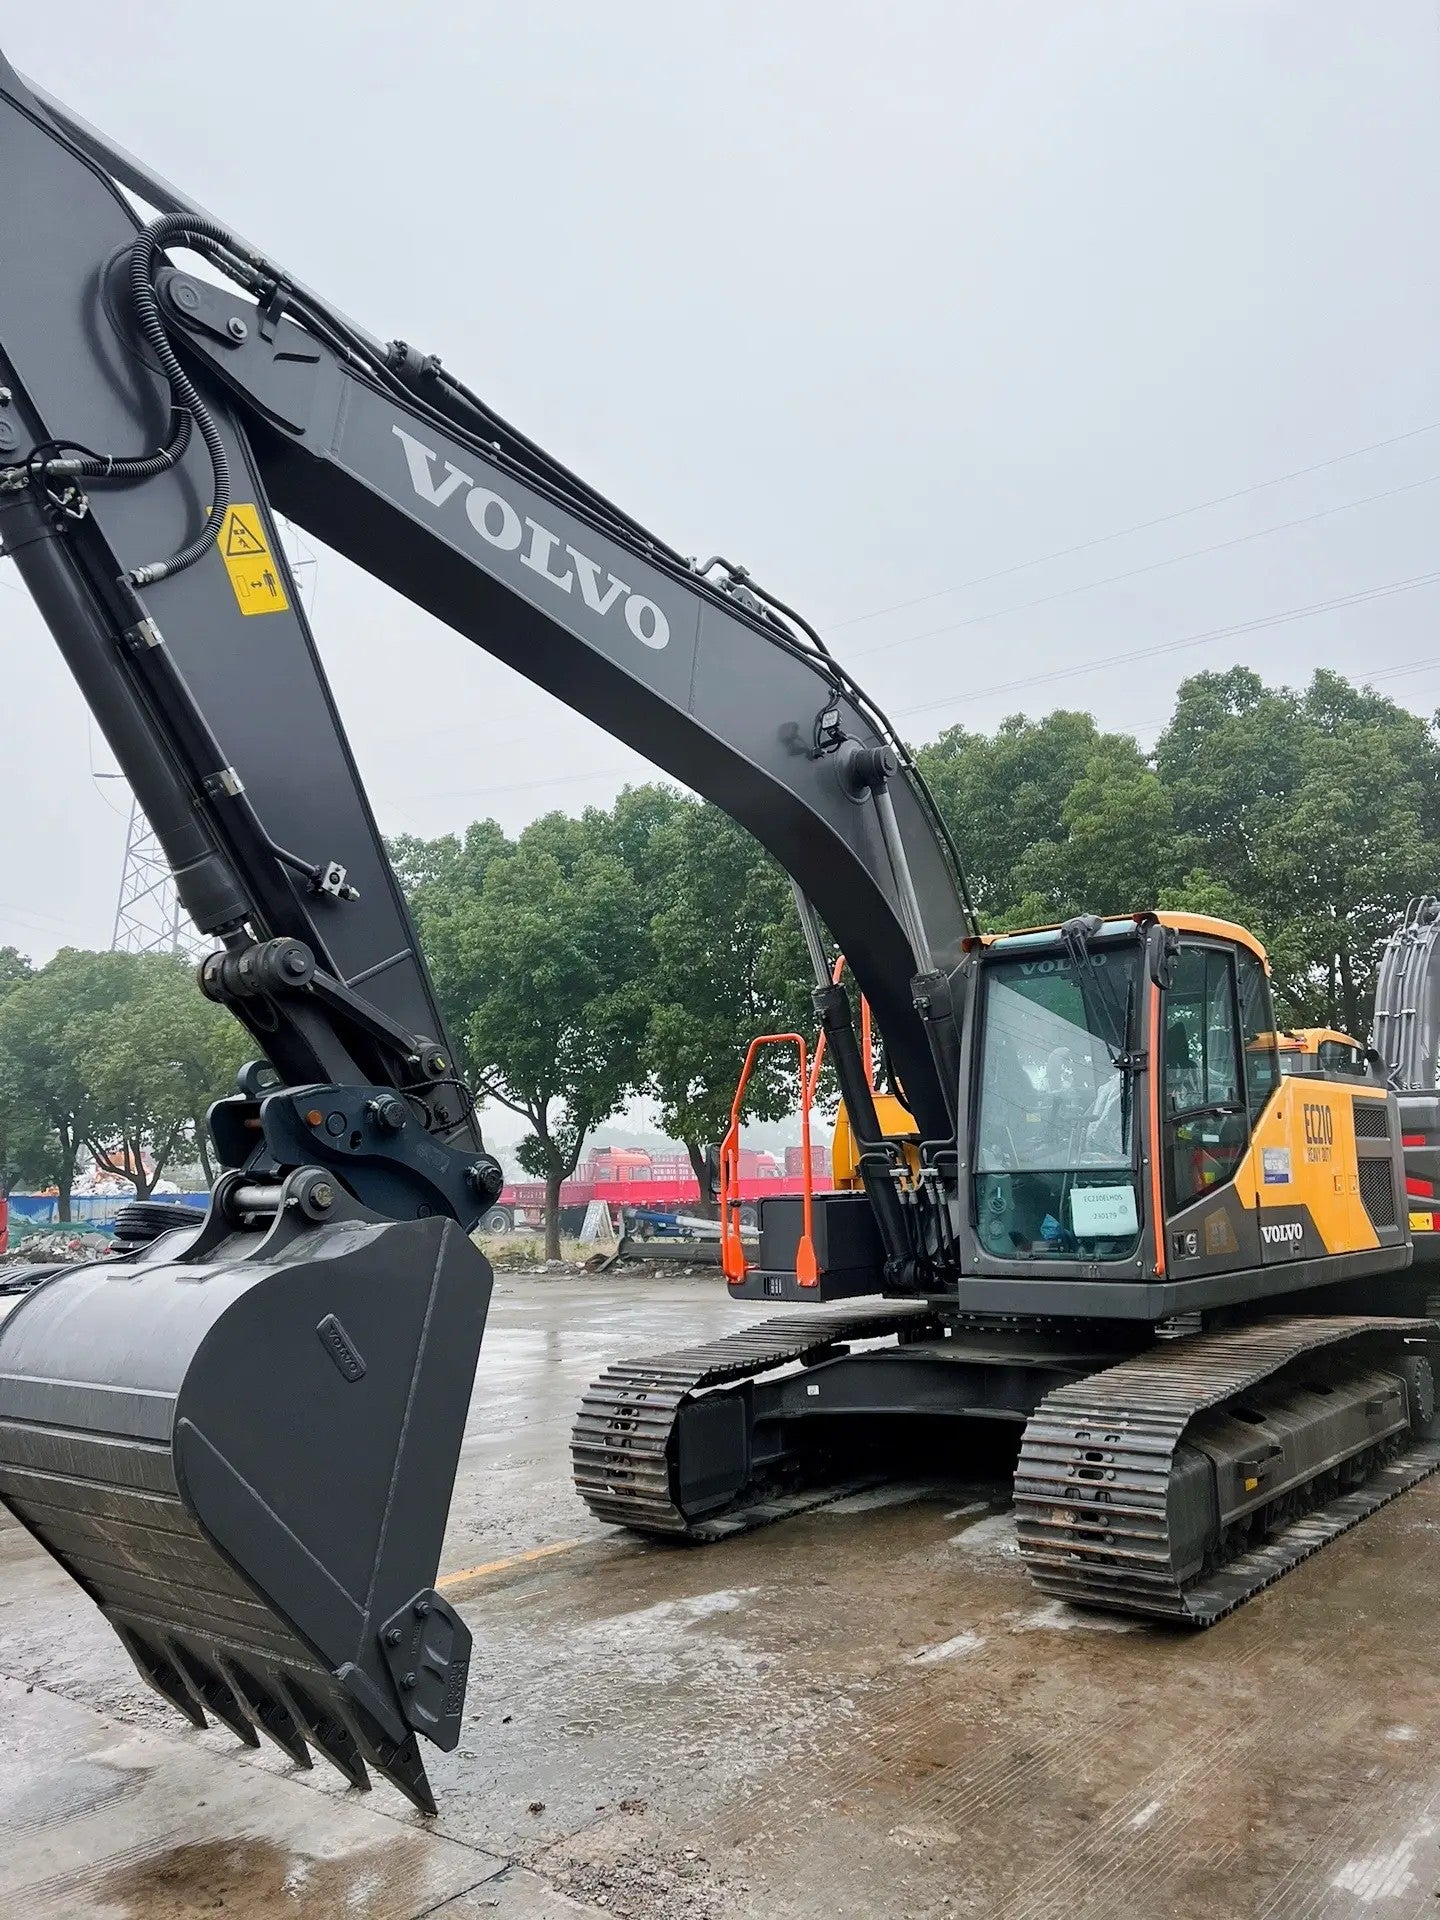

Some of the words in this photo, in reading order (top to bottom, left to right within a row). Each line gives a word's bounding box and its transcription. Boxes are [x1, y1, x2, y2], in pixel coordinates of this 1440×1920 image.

[391, 424, 671, 650] VOLVO
[1304, 1104, 1332, 1145] EC210
[1261, 1223, 1303, 1243] VOLVO
[328, 1323, 358, 1374] VOLVO
